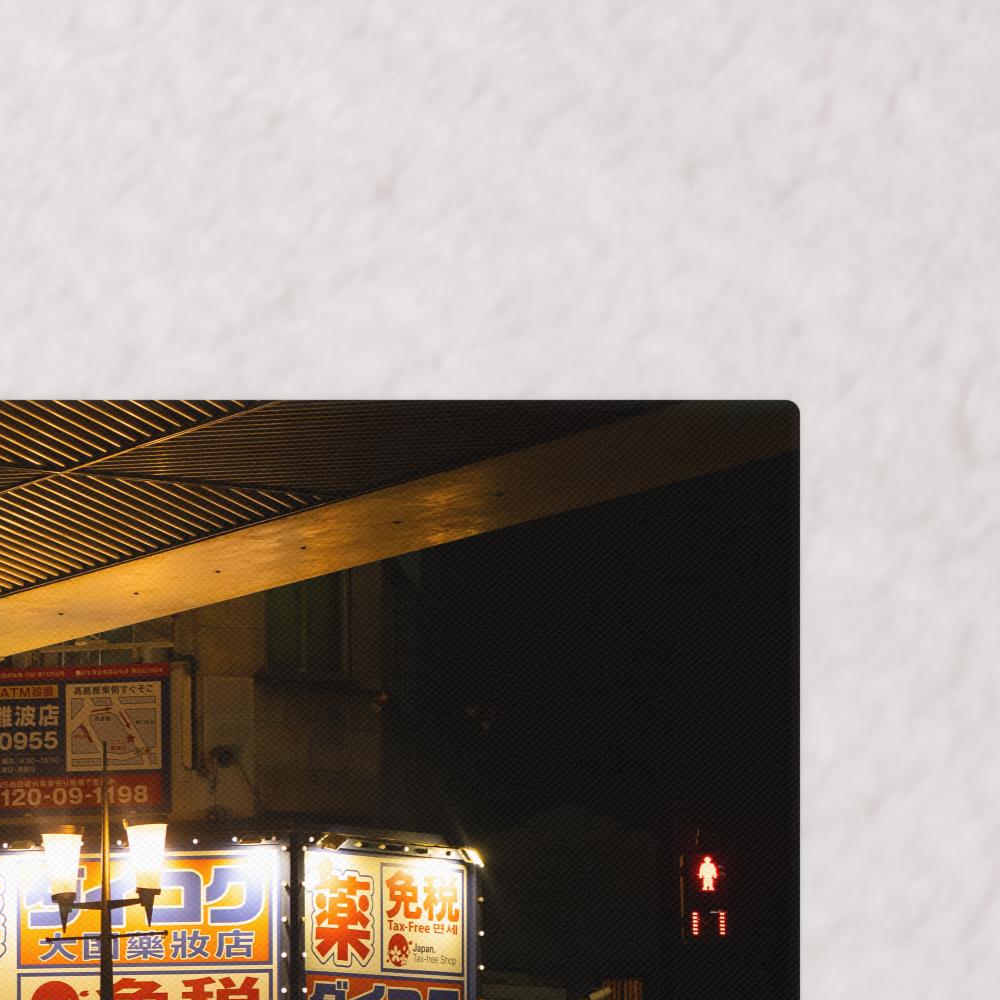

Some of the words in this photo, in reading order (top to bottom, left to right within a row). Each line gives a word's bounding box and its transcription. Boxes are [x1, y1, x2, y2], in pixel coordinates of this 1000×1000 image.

[385, 871, 460, 924] 免税
[314, 873, 372, 962] 薬
[388, 920, 430, 935] Tax-Free
[433, 924, 459, 937] 면세
[412, 952, 439, 966] Tax-free
